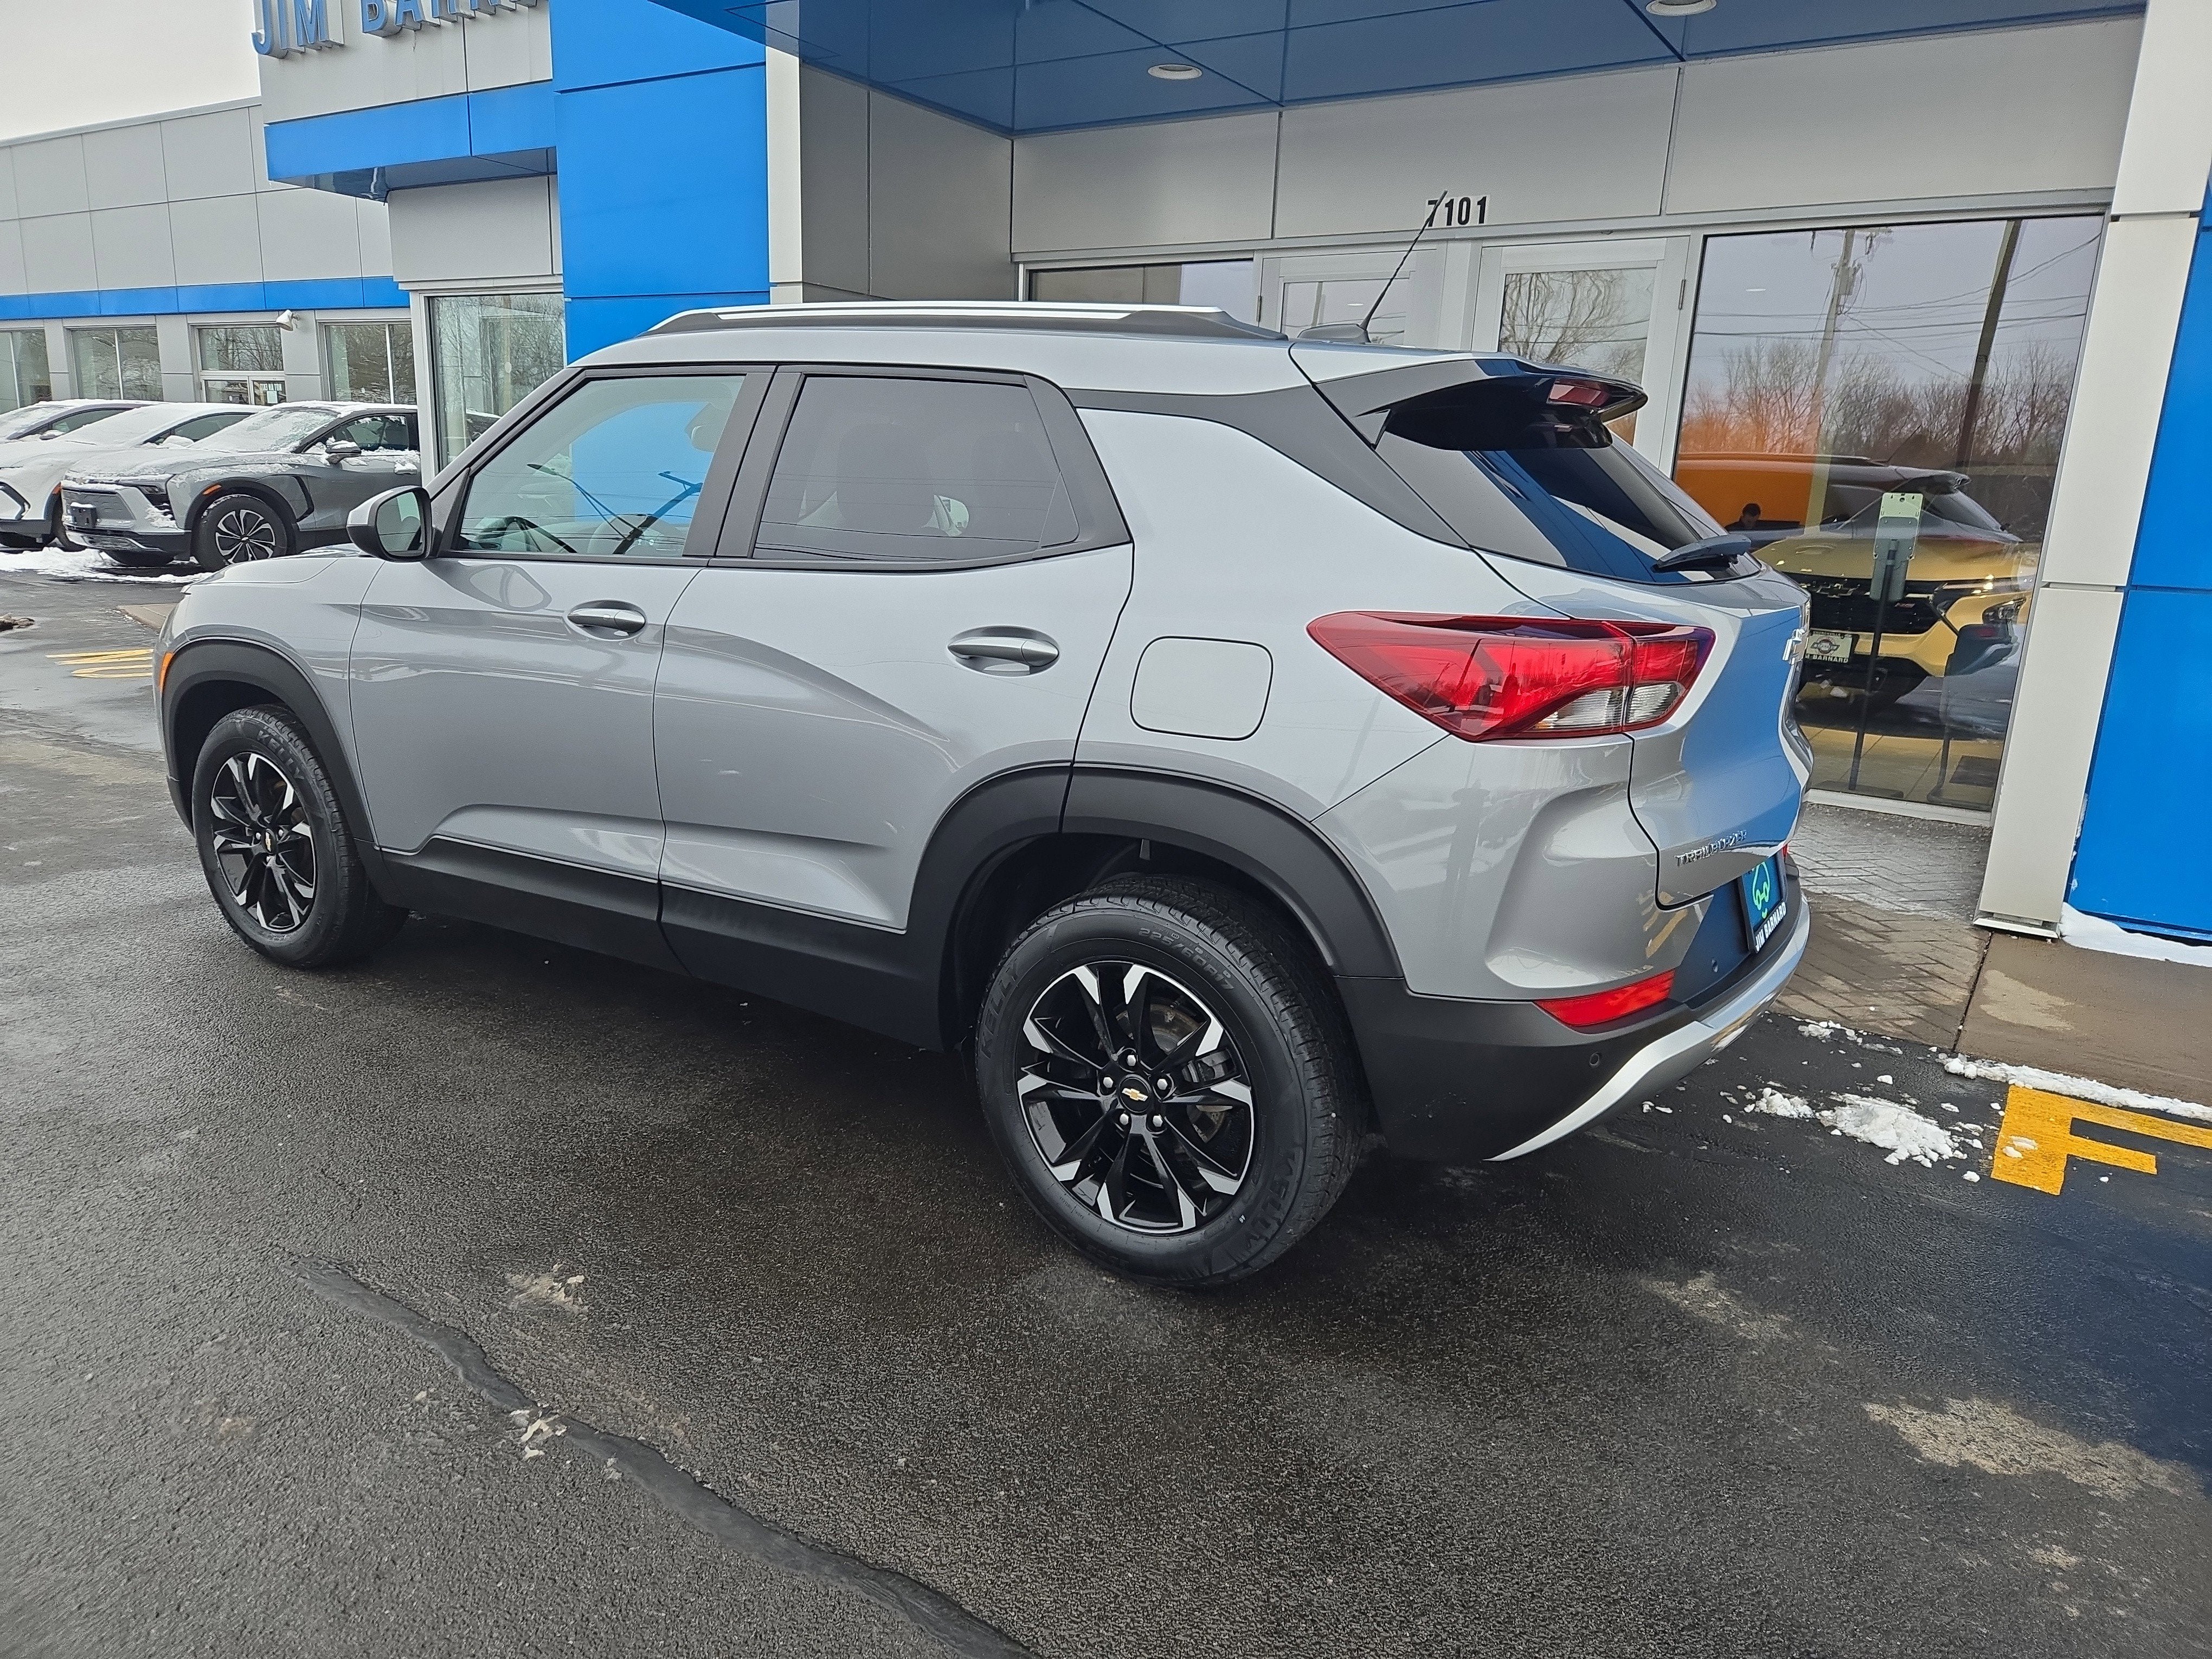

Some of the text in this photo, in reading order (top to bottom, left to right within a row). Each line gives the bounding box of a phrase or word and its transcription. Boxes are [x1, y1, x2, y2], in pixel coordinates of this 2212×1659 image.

[251, 0, 337, 55] JIM
[1427, 195, 1487, 227] 7101
[1755, 901, 1786, 953] JIM BARNARD
[980, 956, 1019, 1060] KELLY
